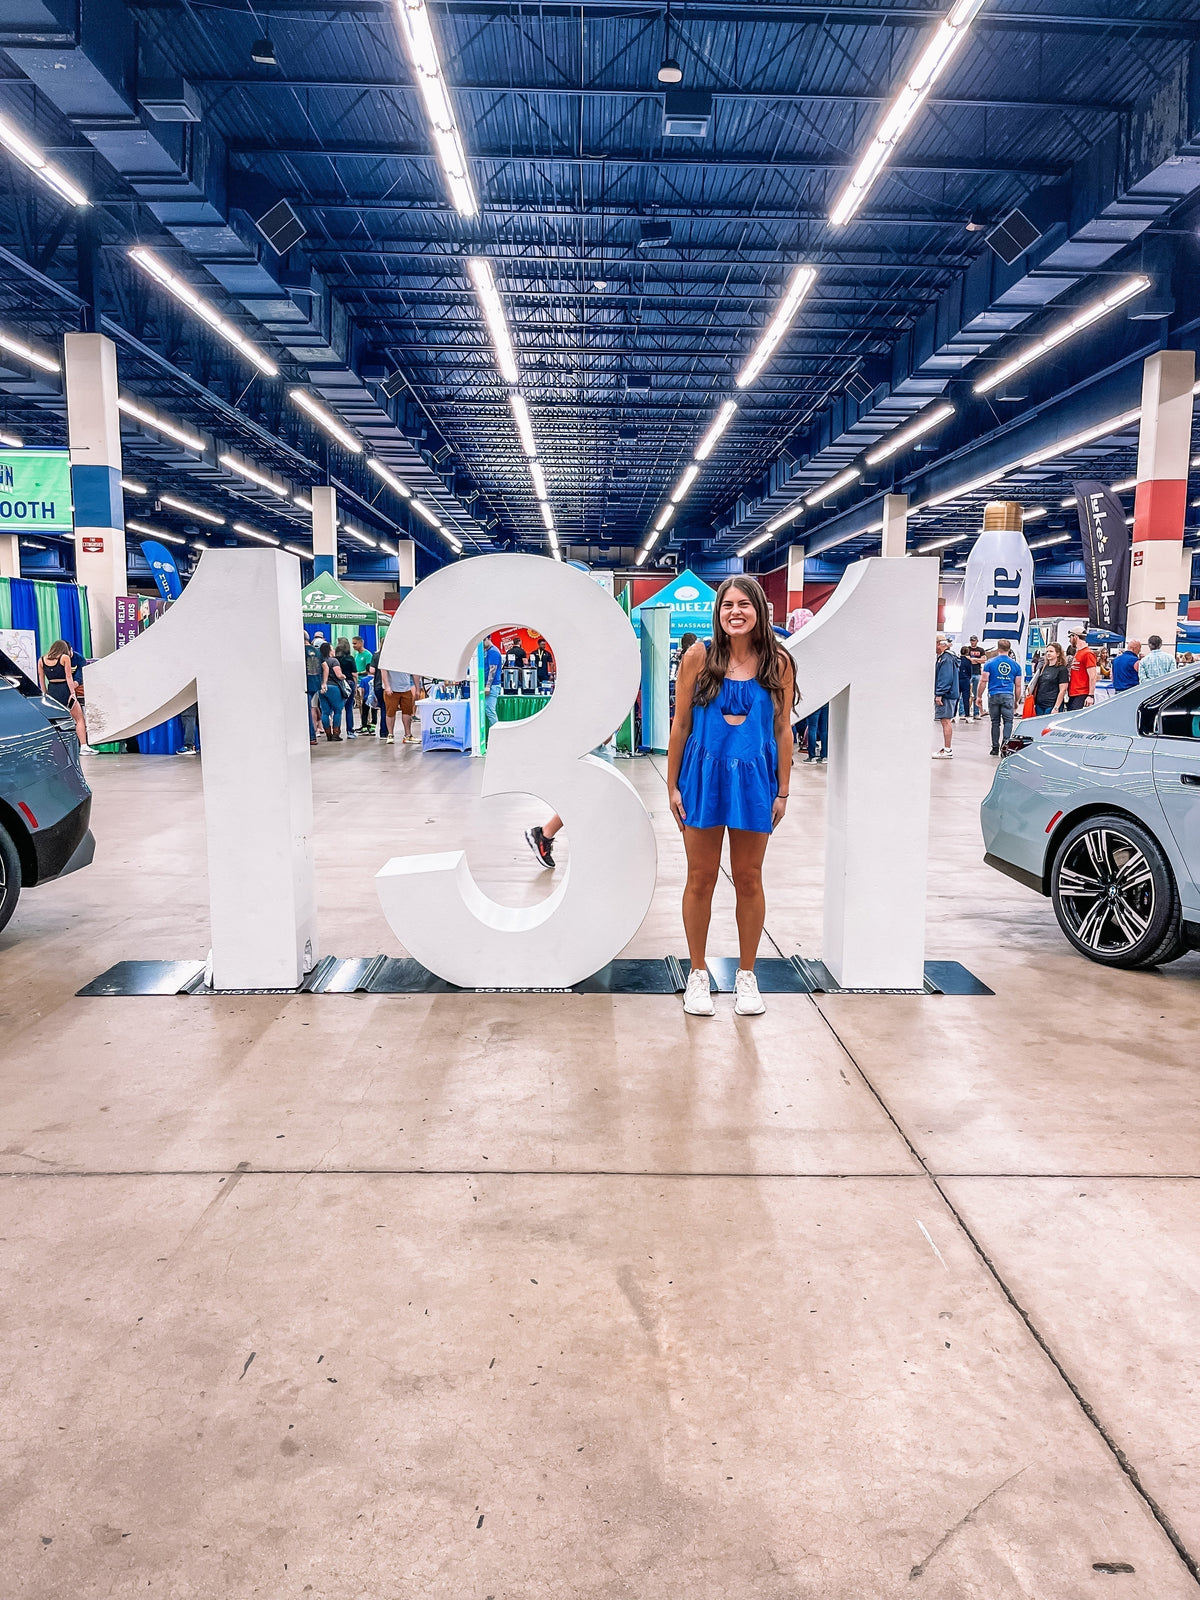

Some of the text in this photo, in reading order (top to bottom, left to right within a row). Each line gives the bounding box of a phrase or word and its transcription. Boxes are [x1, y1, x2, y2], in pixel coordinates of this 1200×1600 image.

[158, 573, 170, 593] run
[1098, 559, 1116, 625] locker
[128, 603, 136, 621] KIDS
[982, 567, 1025, 645] Lite
[118, 600, 126, 648] ALF RELAY
[429, 726, 455, 735] LEAN
[1065, 732, 1085, 743] you
